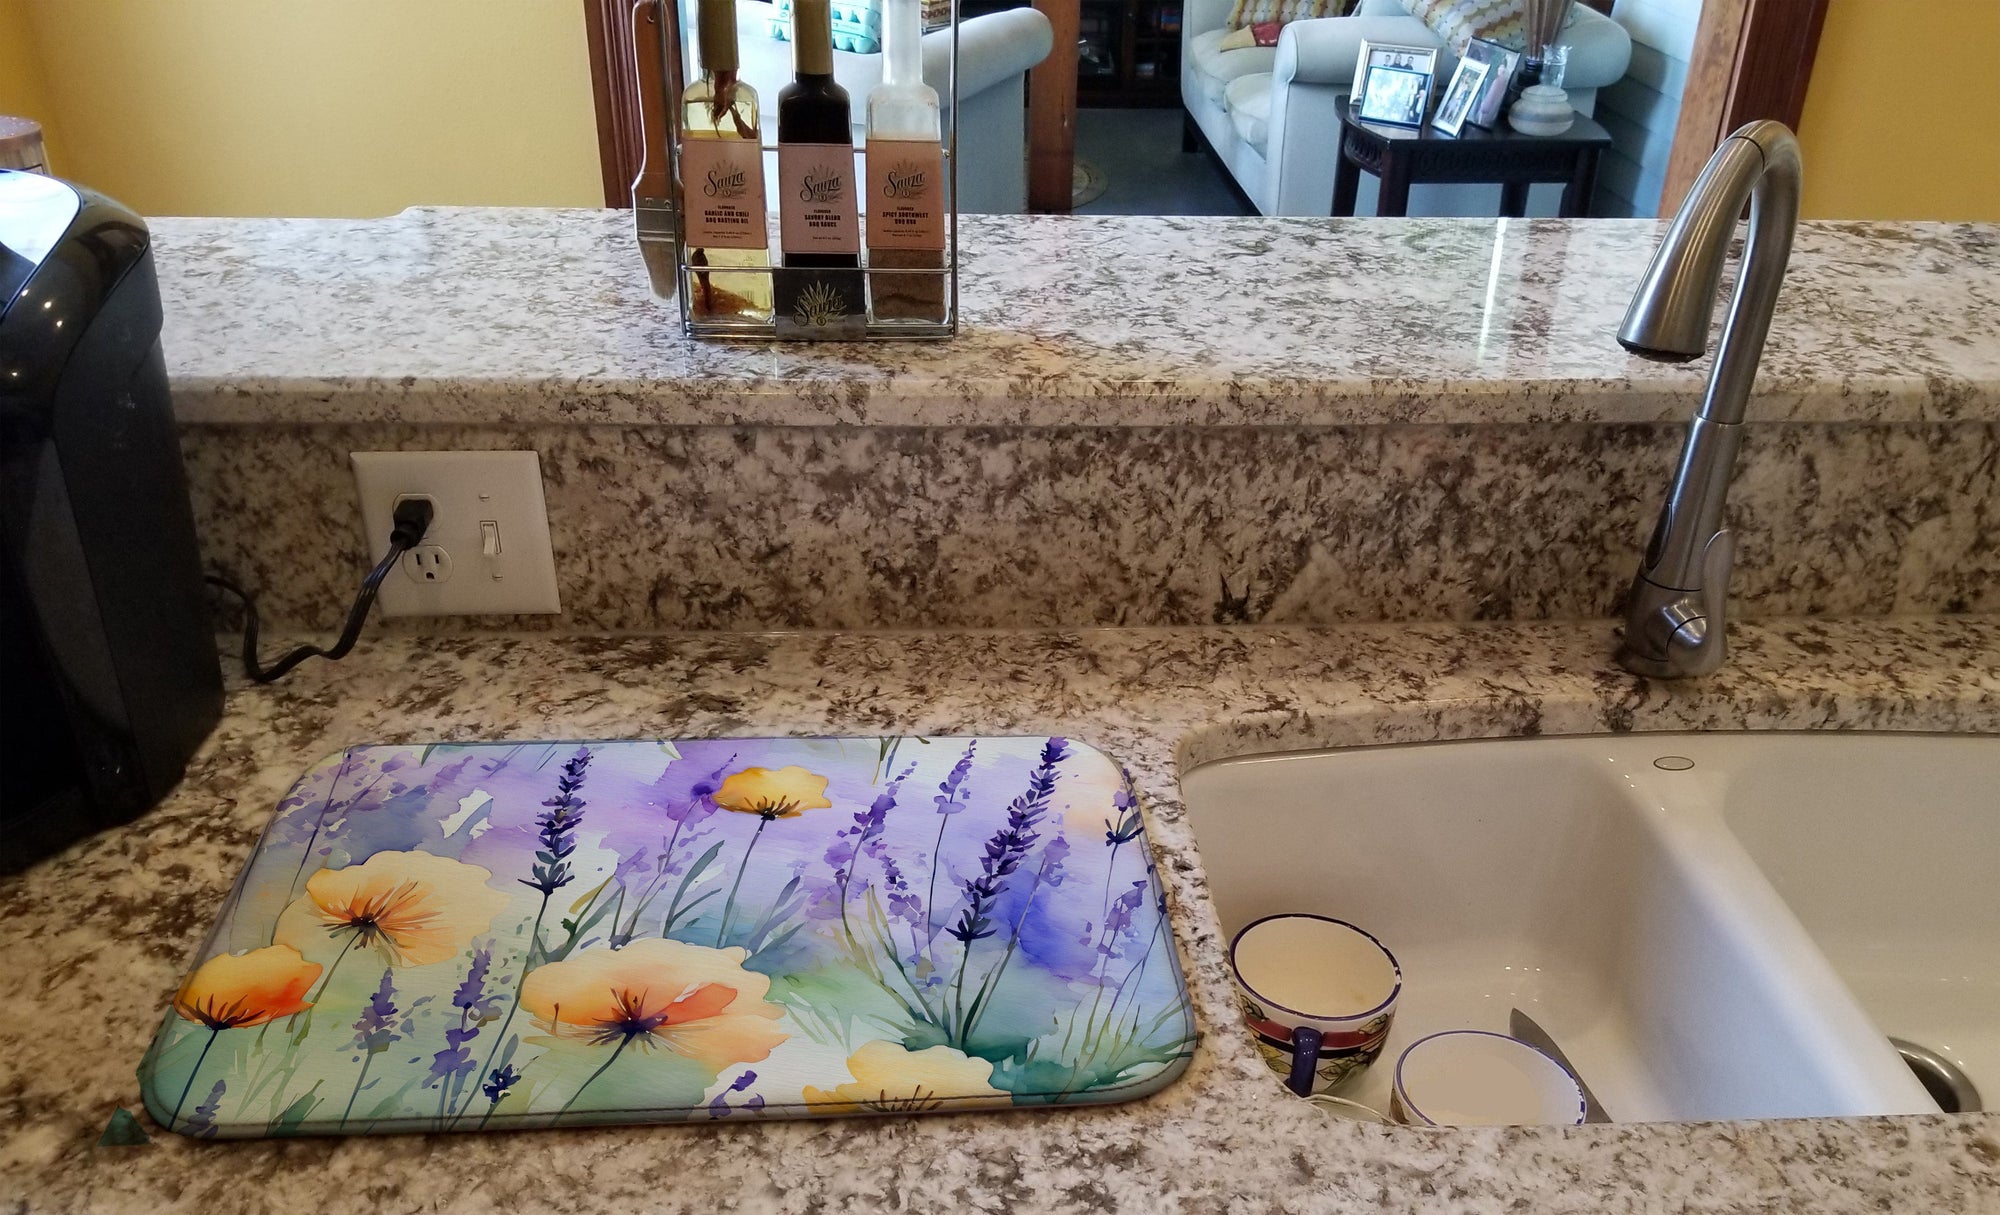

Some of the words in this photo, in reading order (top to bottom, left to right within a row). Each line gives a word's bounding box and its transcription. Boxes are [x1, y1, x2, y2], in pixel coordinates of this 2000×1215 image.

[703, 170, 746, 197] Sauza
[800, 175, 841, 202] Sauza
[883, 171, 925, 198] Sauza
